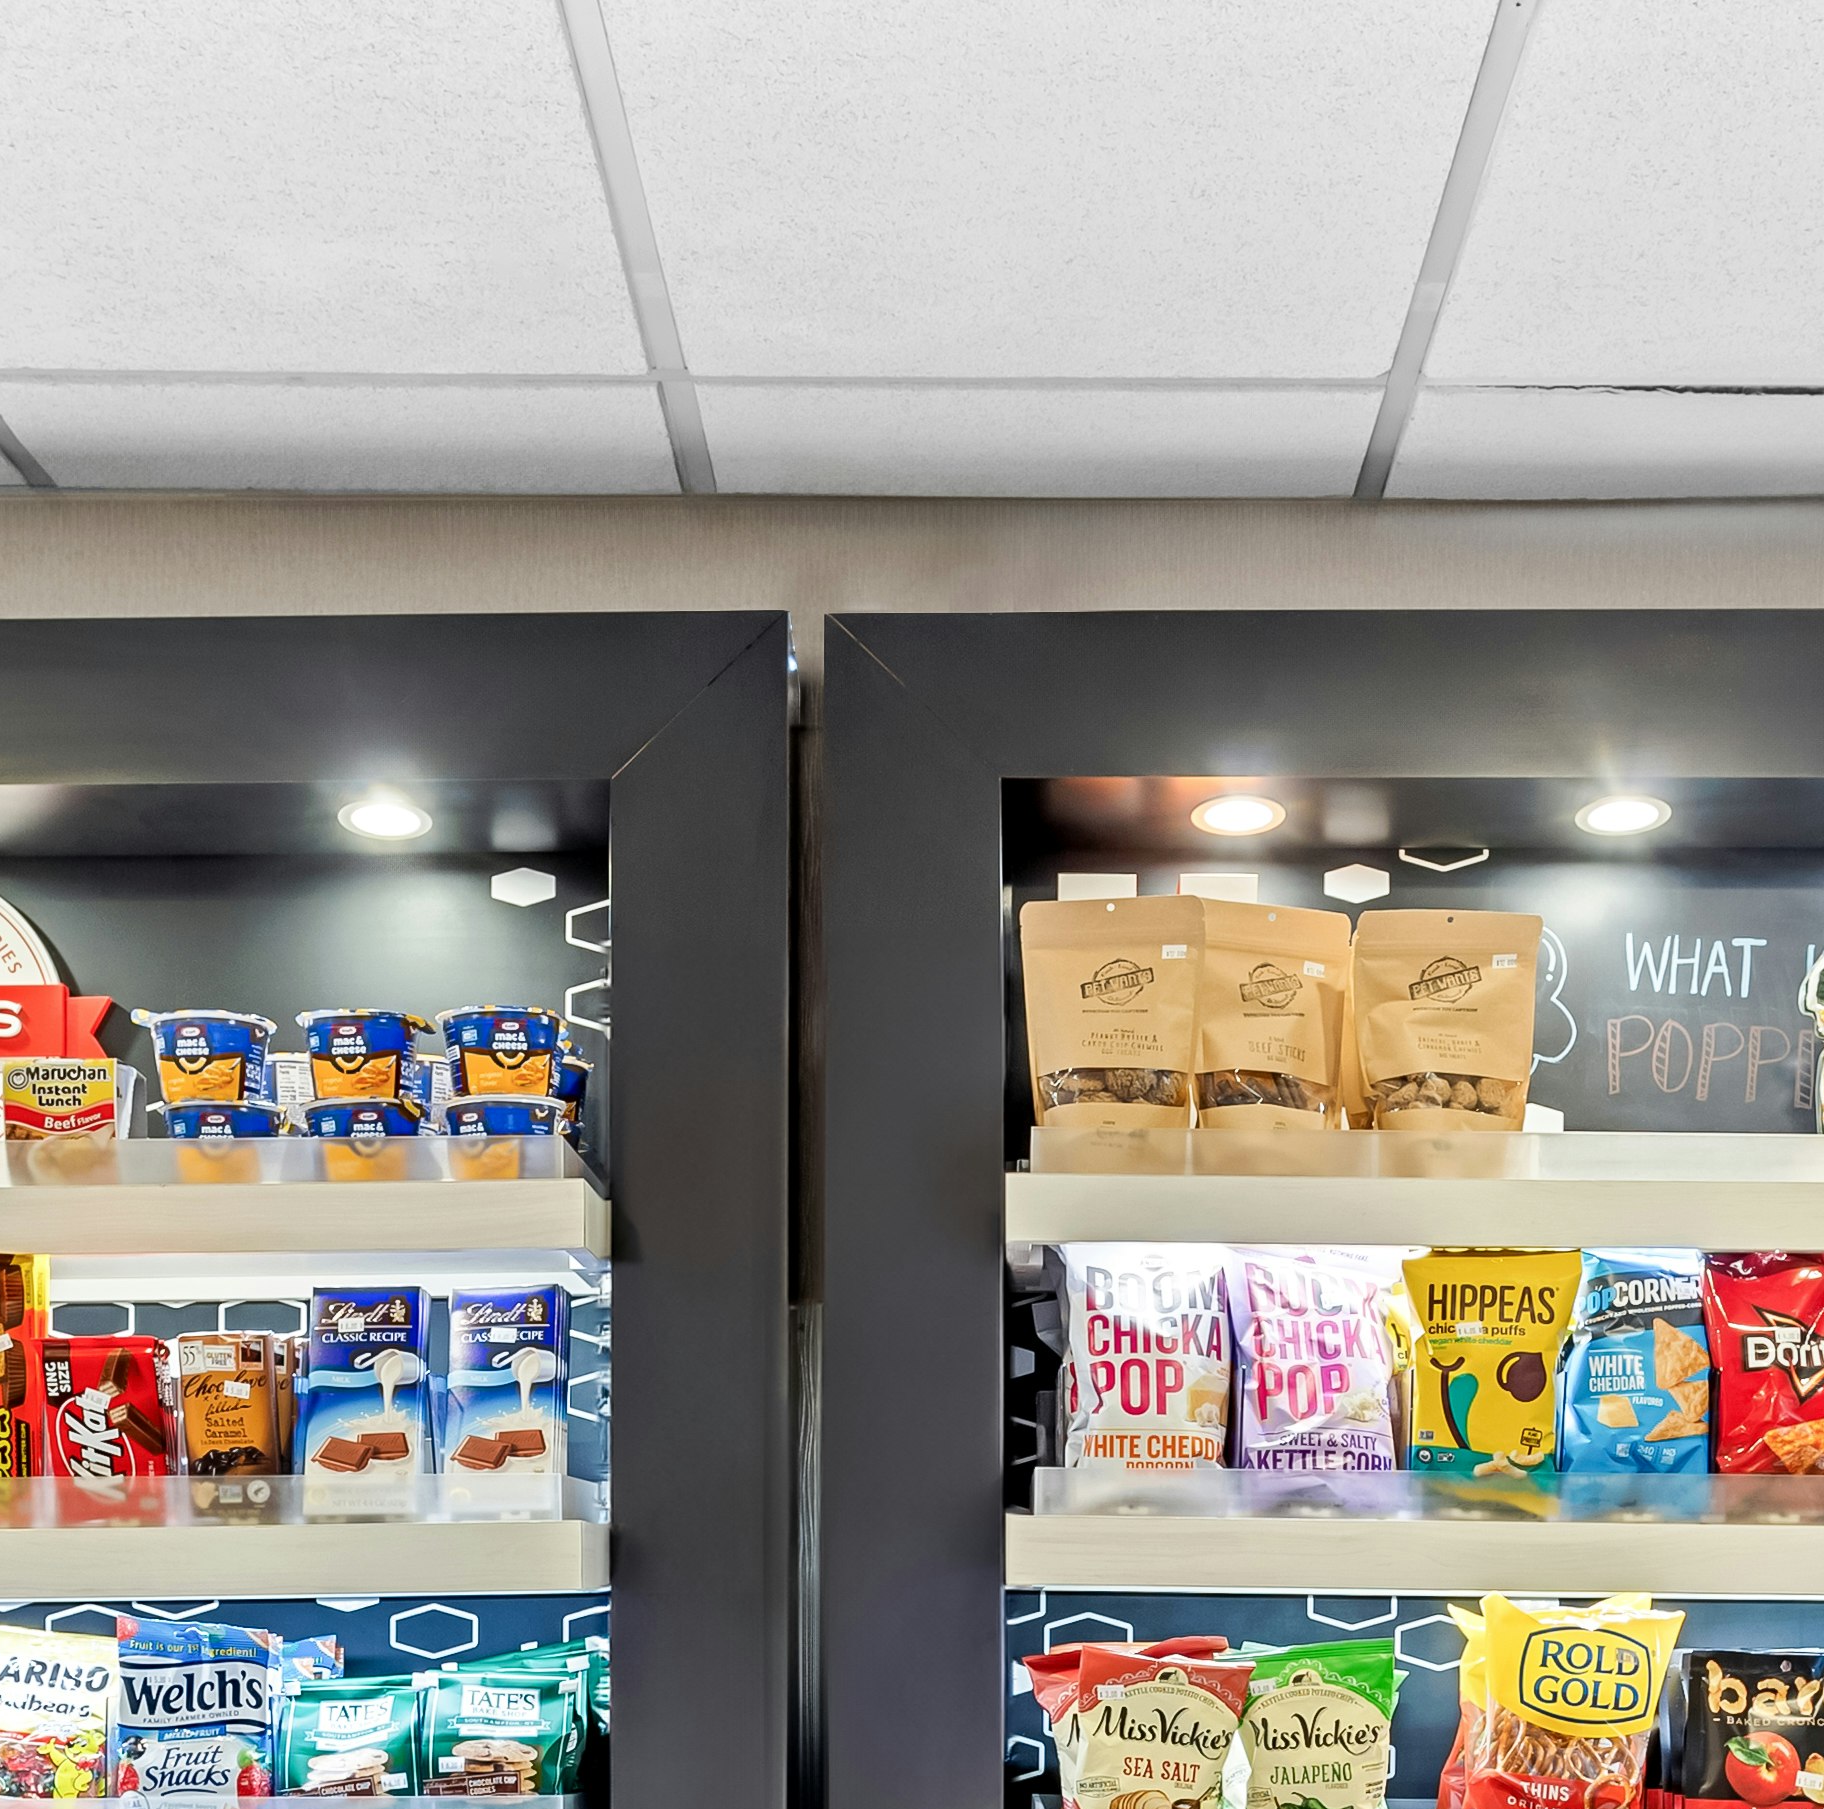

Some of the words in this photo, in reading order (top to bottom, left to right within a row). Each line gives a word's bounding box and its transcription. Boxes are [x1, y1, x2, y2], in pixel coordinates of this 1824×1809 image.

[1625, 932, 1768, 999] WHAT
[25, 1065, 108, 1082] Maruchan
[1606, 1014, 1815, 1110] POPPI
[31, 1082, 88, 1096] Instant
[37, 1094, 83, 1108] Lunch
[44, 1114, 78, 1130] Beef
[76, 1112, 102, 1127] Flavor
[1427, 1283, 1556, 1325] HIPPEAS
[321, 1331, 368, 1344] CLASSIC
[369, 1331, 407, 1343] RECIPE
[1087, 1313, 1223, 1362] CHICKA
[57, 1361, 72, 1394] SIZE
[1588, 1354, 1645, 1377] WHITE
[45, 1361, 60, 1397] KING
[1090, 1358, 1184, 1416] POP
[1588, 1375, 1645, 1393] CHEDDAR
[1257, 1361, 1351, 1422] POP
[1632, 1395, 1664, 1407] FLAVORED
[204, 1427, 247, 1439] Caramel
[206, 1416, 245, 1427] Salted
[1279, 1432, 1323, 1448] SWEET
[1326, 1433, 1339, 1448] &
[1340, 1433, 1378, 1451] SALTY
[1539, 1639, 1640, 1677] ROLD
[120, 1669, 264, 1716] Welch's
[468, 1689, 536, 1712] TATE'S
[1533, 1675, 1640, 1712] GOLD
[326, 1699, 388, 1722] TATE'S
[1726, 1716, 1772, 1728] BAKED
[160, 1745, 224, 1771] Fruit
[1123, 1756, 1155, 1781] SEA
[1161, 1760, 1201, 1784] SALT
[142, 1766, 231, 1793] Snacks
[1269, 1760, 1354, 1786] JALAPEÑO
[1519, 1780, 1571, 1802] THINS
